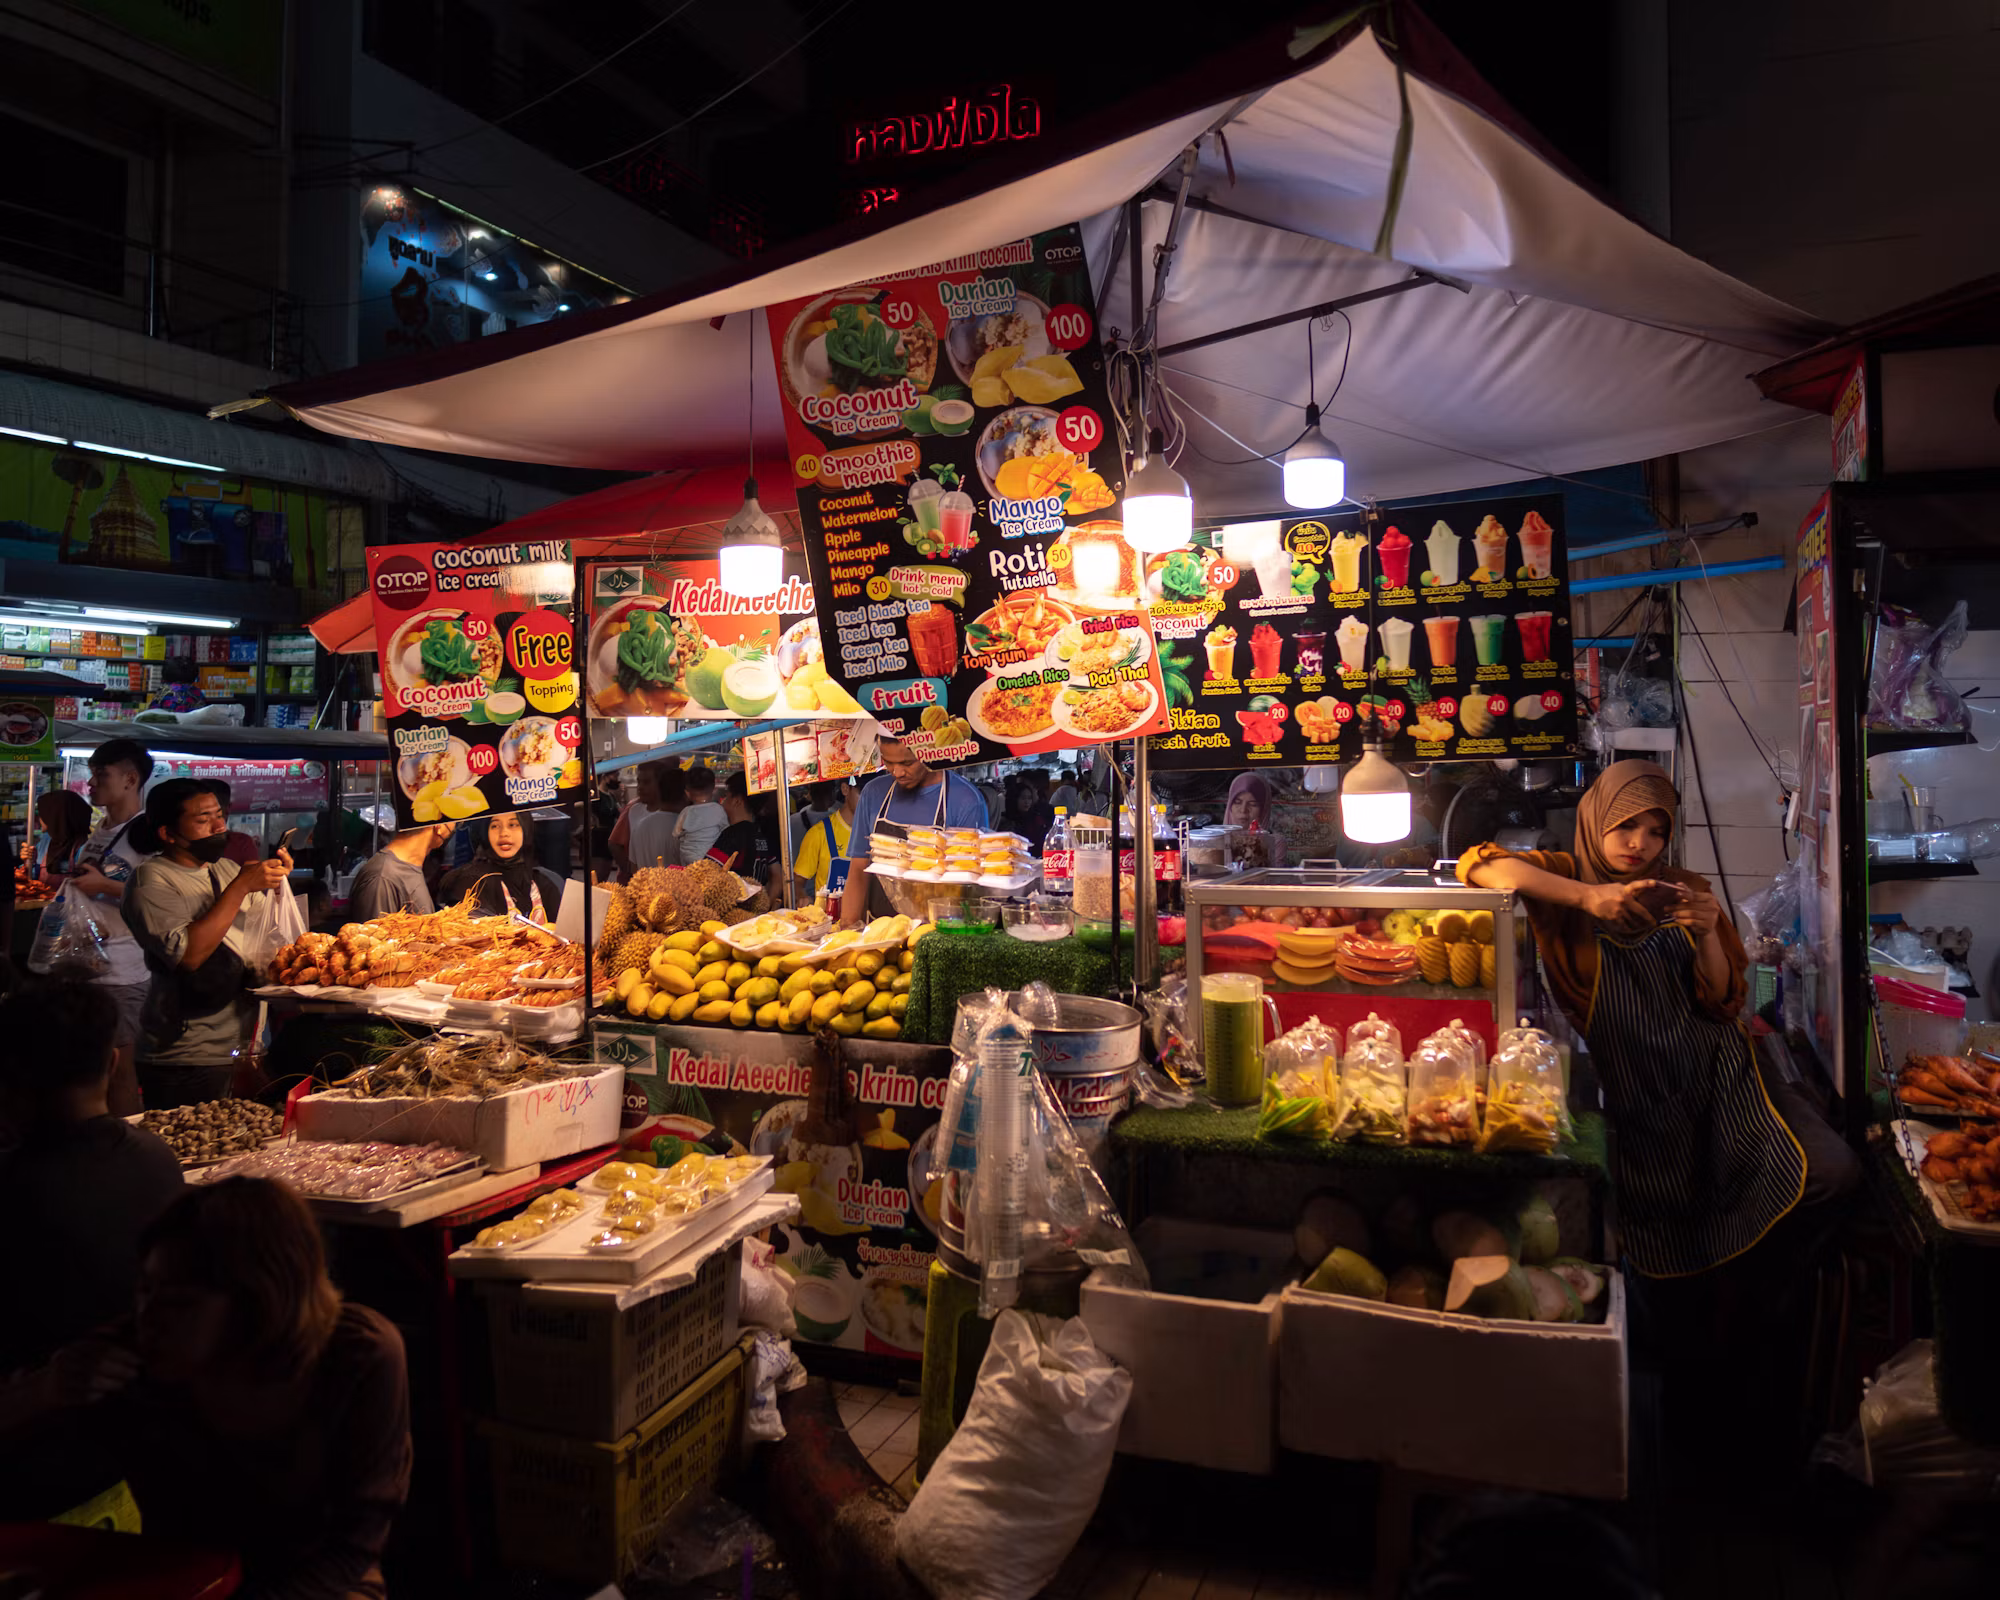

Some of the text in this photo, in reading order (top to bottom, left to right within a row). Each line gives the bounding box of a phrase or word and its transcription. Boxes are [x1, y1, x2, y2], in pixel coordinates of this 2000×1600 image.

[980, 238, 1033, 268] coconut
[1044, 246, 1082, 260] OTOP
[939, 275, 1015, 305] Durian
[887, 301, 914, 323] 50
[949, 298, 1012, 318] Ice Cream
[1049, 314, 1087, 341] 100
[801, 380, 918, 422] Coconut
[834, 414, 898, 434] Ice Cream
[1064, 414, 1097, 442] 50
[801, 458, 817, 473] 40
[822, 443, 915, 475] Smoothie
[843, 465, 896, 488] menu
[819, 491, 874, 511] Coconut
[990, 496, 1061, 522] Mango
[822, 507, 898, 528] Watermelon
[1001, 517, 1062, 536] Ice Cream
[825, 529, 862, 548] Apple
[433, 540, 567, 569] coconut milk
[828, 541, 890, 564] Pineapple
[989, 542, 1047, 577] Roti
[1051, 549, 1068, 563] 50
[376, 571, 429, 588] OTOP
[437, 571, 511, 591] ice cream
[830, 564, 874, 581] Mango
[891, 568, 964, 587] Drink menu
[999, 570, 1057, 591] Tutuella
[1213, 565, 1235, 584] 50
[671, 580, 729, 614] Kedai
[833, 582, 861, 598] Milo
[871, 581, 888, 595] 30
[903, 583, 952, 596] hot cold
[836, 600, 931, 626] Iced black tea
[467, 620, 488, 636] 50
[839, 623, 894, 643] Iced tea
[1082, 614, 1139, 635] Fried rice
[512, 625, 573, 668] Free
[842, 639, 907, 660] Green tea
[844, 656, 906, 678] Iced Milo
[961, 649, 1027, 669] Tom yum
[997, 667, 1070, 690] Omelet Rice
[1088, 663, 1149, 688] Pad Thai
[399, 678, 487, 705] Coconut
[529, 682, 574, 697] Topping
[871, 681, 937, 710] fruit
[423, 702, 470, 715] Ice Cream
[1387, 704, 1402, 716] 20
[1439, 702, 1454, 714] 20
[1490, 700, 1505, 712] 40
[1543, 696, 1559, 708] 40
[1271, 708, 1285, 719] 20
[1335, 708, 1350, 719] 20
[395, 726, 448, 746] Durian
[560, 722, 581, 741] 50
[1147, 733, 1231, 749] Fresh fruit
[401, 741, 445, 754] Ice Cream
[916, 741, 978, 761] Pineapple
[469, 749, 494, 768] 100
[507, 776, 555, 795] Mango
[514, 789, 555, 802] Ice Cream
[669, 1050, 728, 1087] Kedai
[734, 1054, 812, 1094] Aeeche
[863, 1064, 917, 1105] krim
[838, 1177, 908, 1210] Durian
[842, 1204, 904, 1226] Ice Cream
